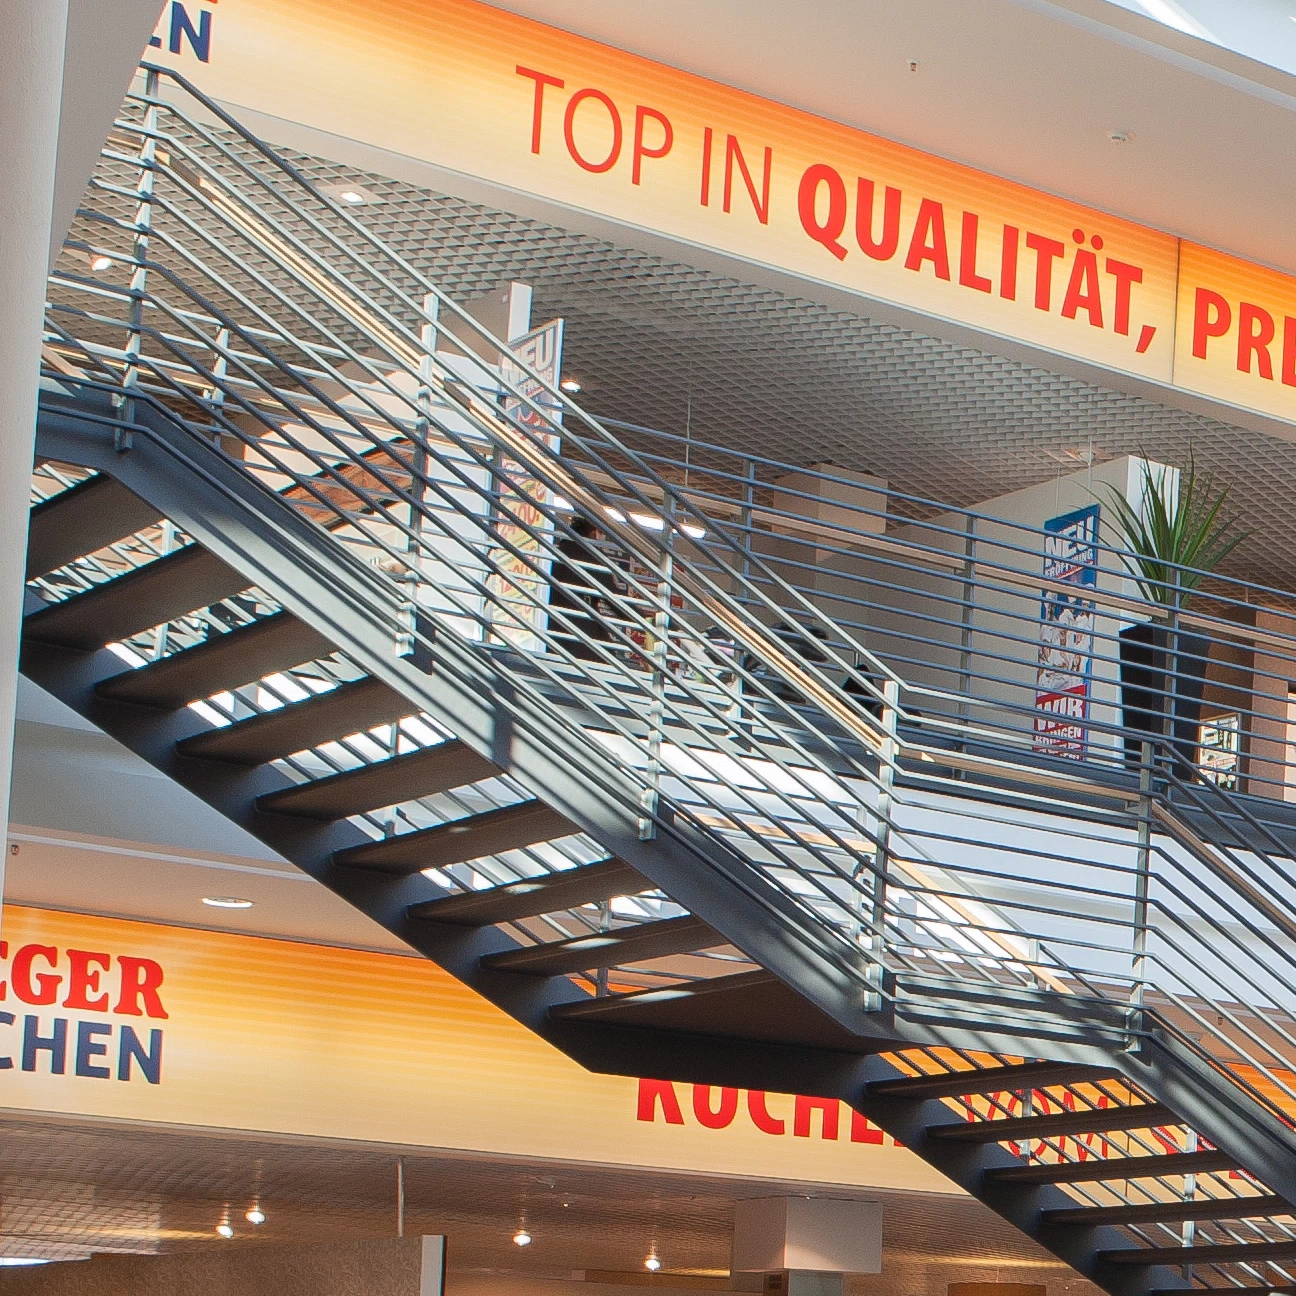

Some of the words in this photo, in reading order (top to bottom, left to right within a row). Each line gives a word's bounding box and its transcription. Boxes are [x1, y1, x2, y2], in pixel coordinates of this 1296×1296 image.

[148, 0, 212, 63] N
[515, 64, 674, 186] TOP
[699, 125, 773, 226] IN
[796, 162, 1157, 354] QUALITÄT,
[0, 940, 169, 1019] GER
